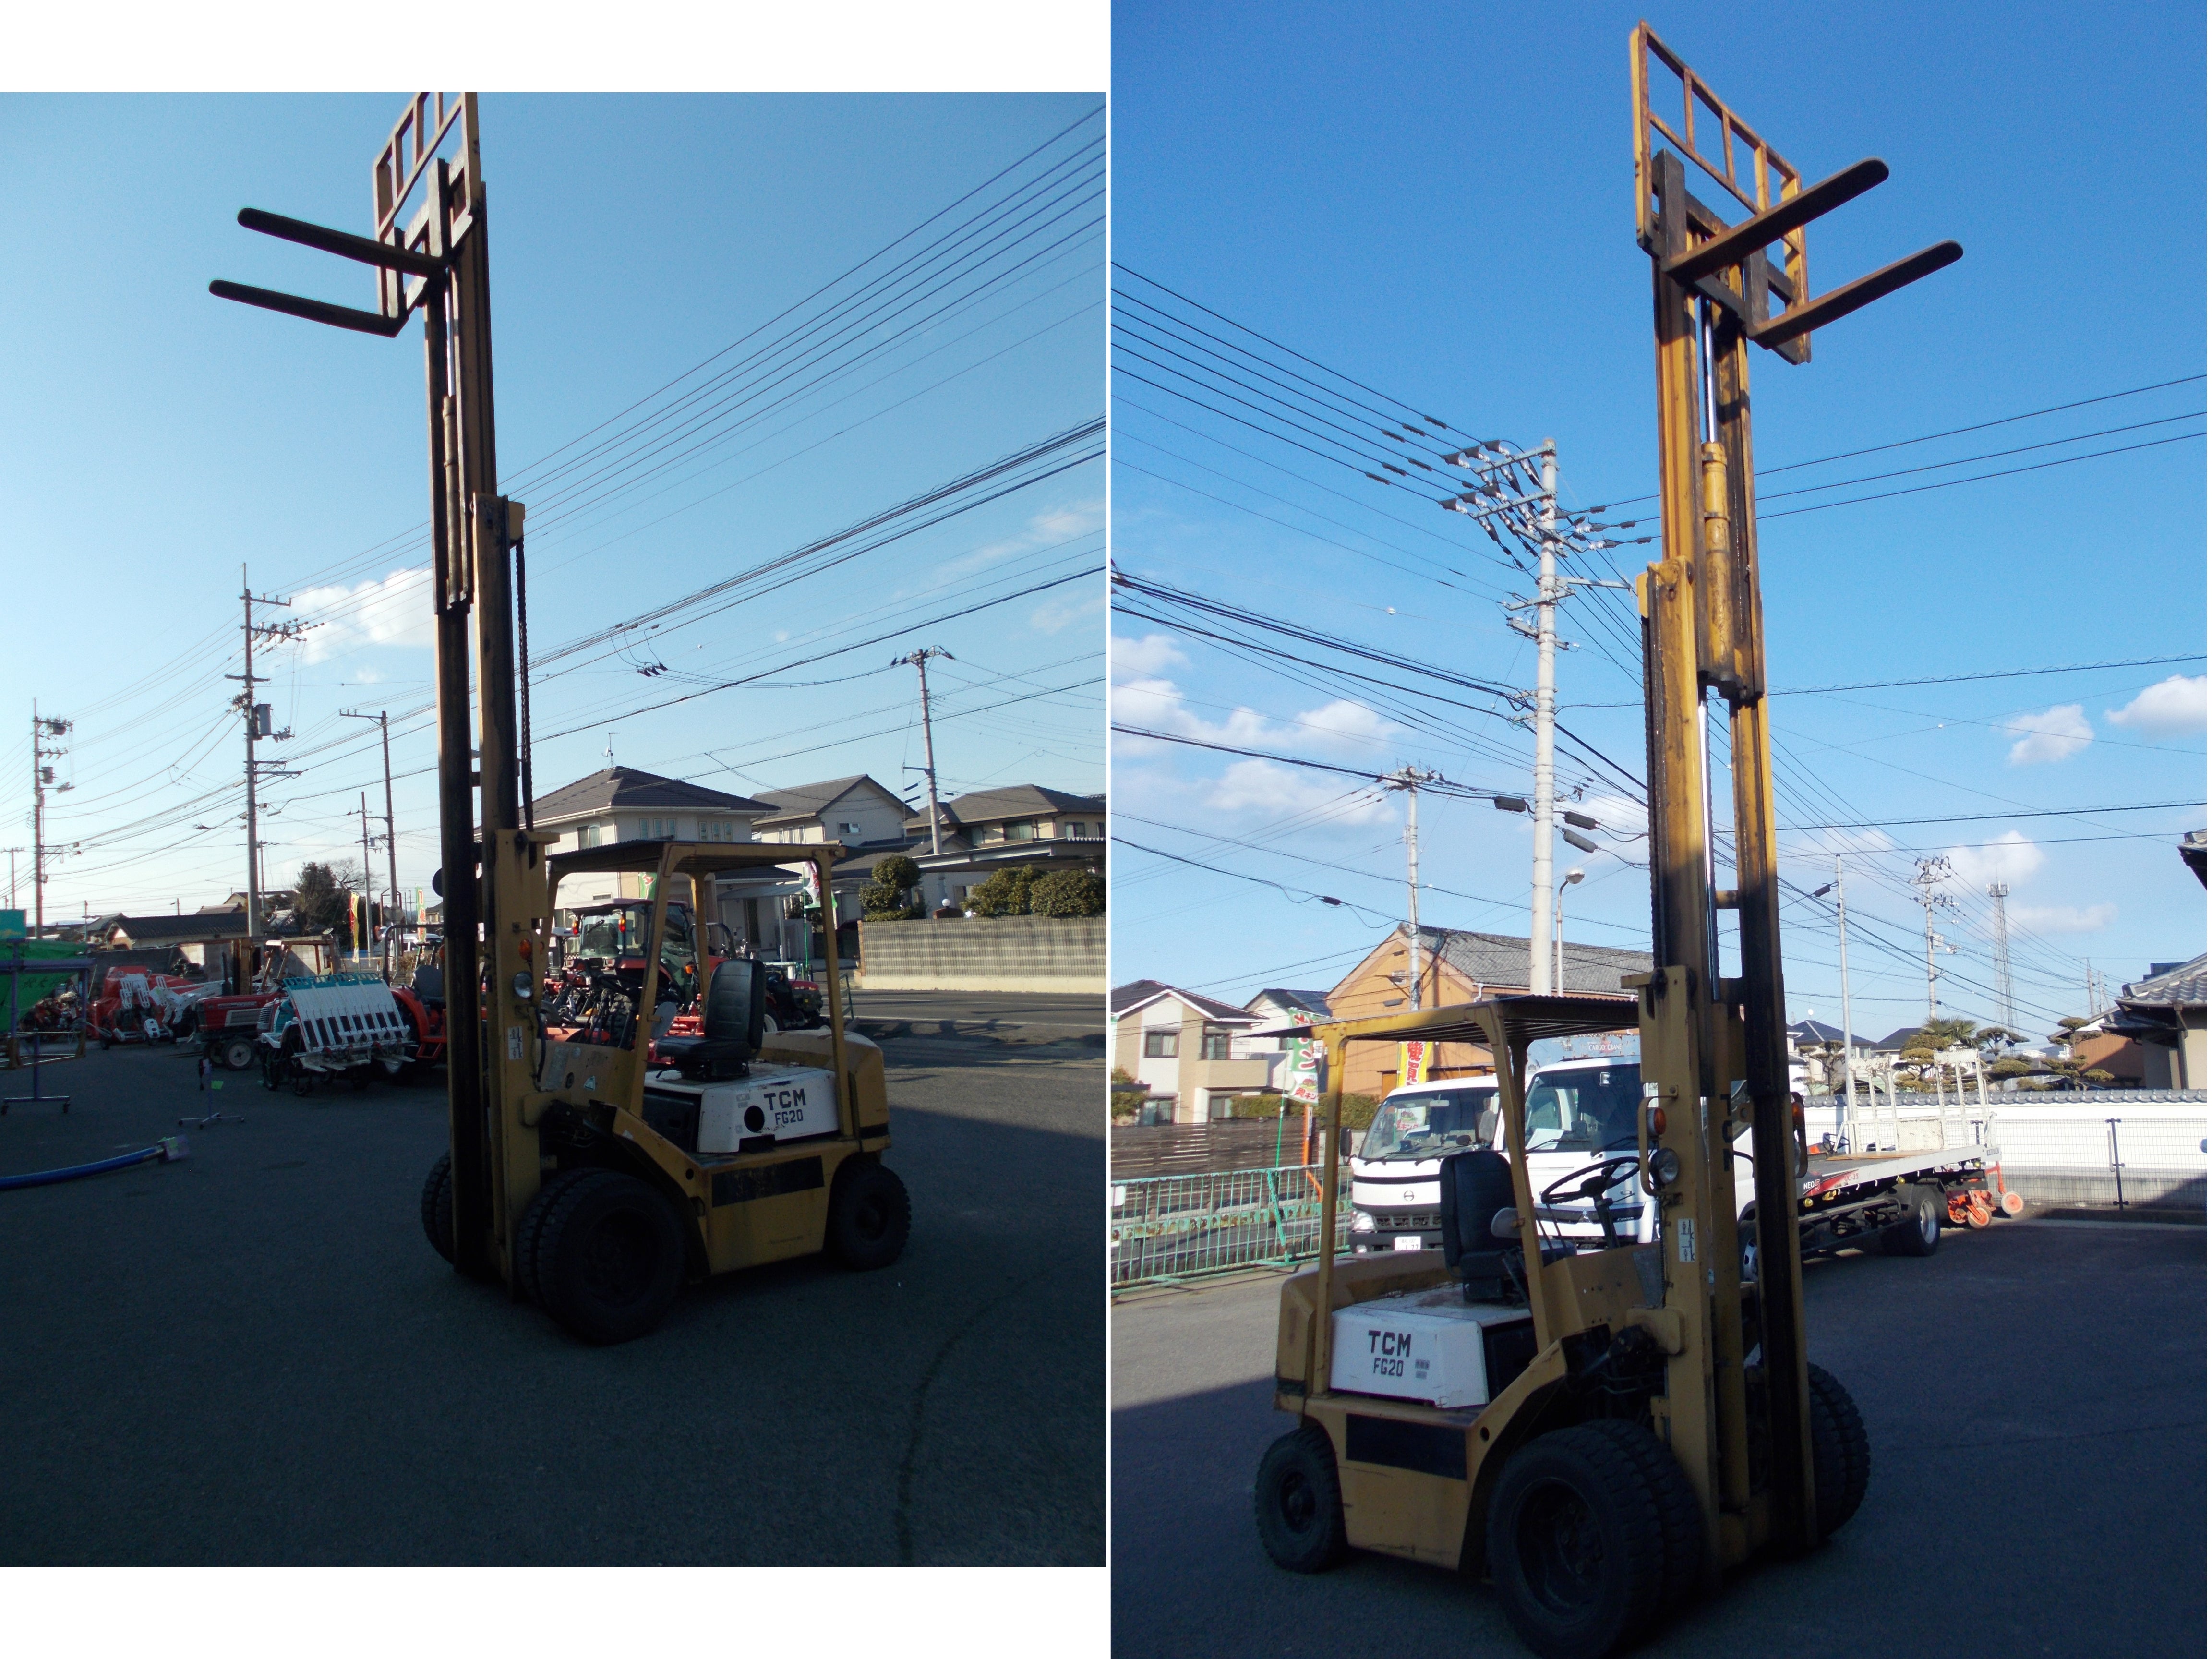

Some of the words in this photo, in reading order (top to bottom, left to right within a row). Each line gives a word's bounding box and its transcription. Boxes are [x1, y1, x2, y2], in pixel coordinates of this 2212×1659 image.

[764, 1088, 806, 1111] TCM
[774, 1109, 804, 1125] FG20
[1368, 1330, 1412, 1358] TCM
[1373, 1357, 1404, 1377] FG20
